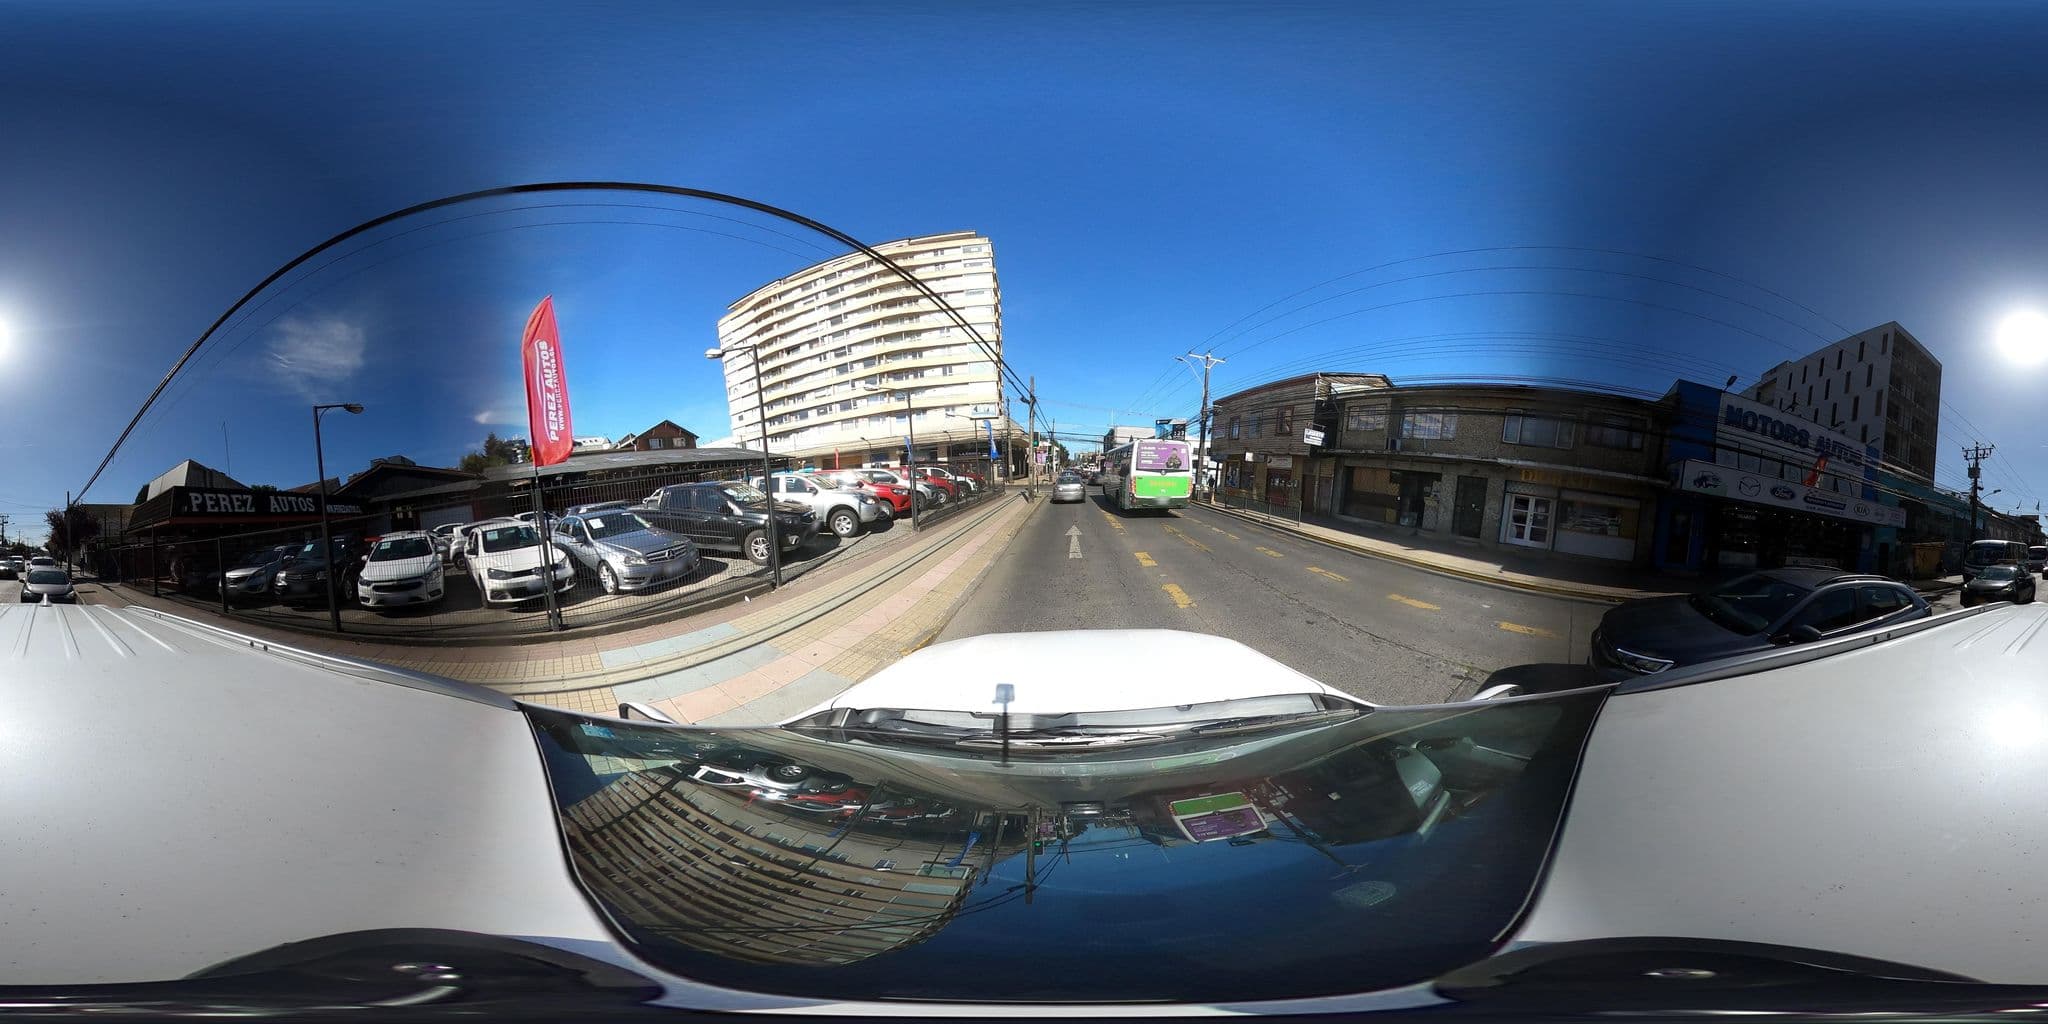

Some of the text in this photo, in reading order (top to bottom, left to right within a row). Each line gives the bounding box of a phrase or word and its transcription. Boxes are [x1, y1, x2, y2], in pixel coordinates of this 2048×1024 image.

[538, 340, 560, 441] PEREZ AUTOS
[1726, 405, 1810, 448] MOTORS
[189, 492, 256, 513] PEREZ
[269, 496, 315, 512] AUTOS
